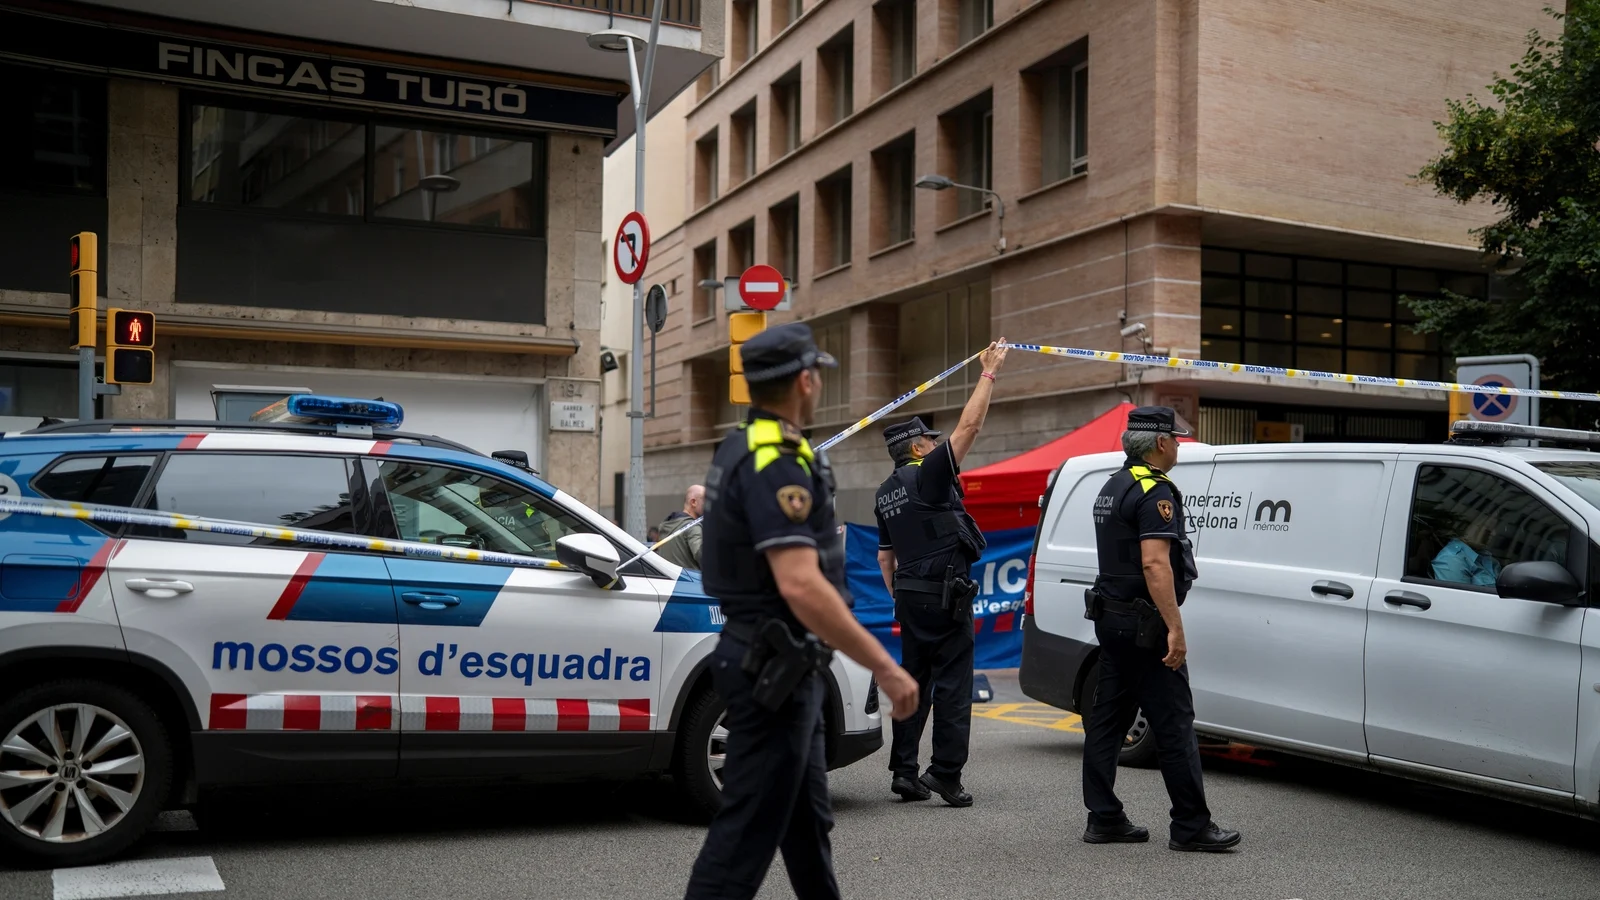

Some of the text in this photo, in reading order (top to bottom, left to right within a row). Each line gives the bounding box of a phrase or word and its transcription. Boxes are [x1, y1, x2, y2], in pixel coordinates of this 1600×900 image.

[159, 41, 527, 115] FINCAS TURÓ
[1123, 354, 1145, 362] POLICIA
[561, 383, 583, 398] 194
[560, 419, 585, 428] BALMES
[878, 486, 908, 508] POLICIA
[1183, 491, 1242, 508] uneraris
[1184, 512, 1238, 530] rcelona
[1252, 522, 1290, 532] mémora
[212, 641, 651, 686] mossos d'esquadra
